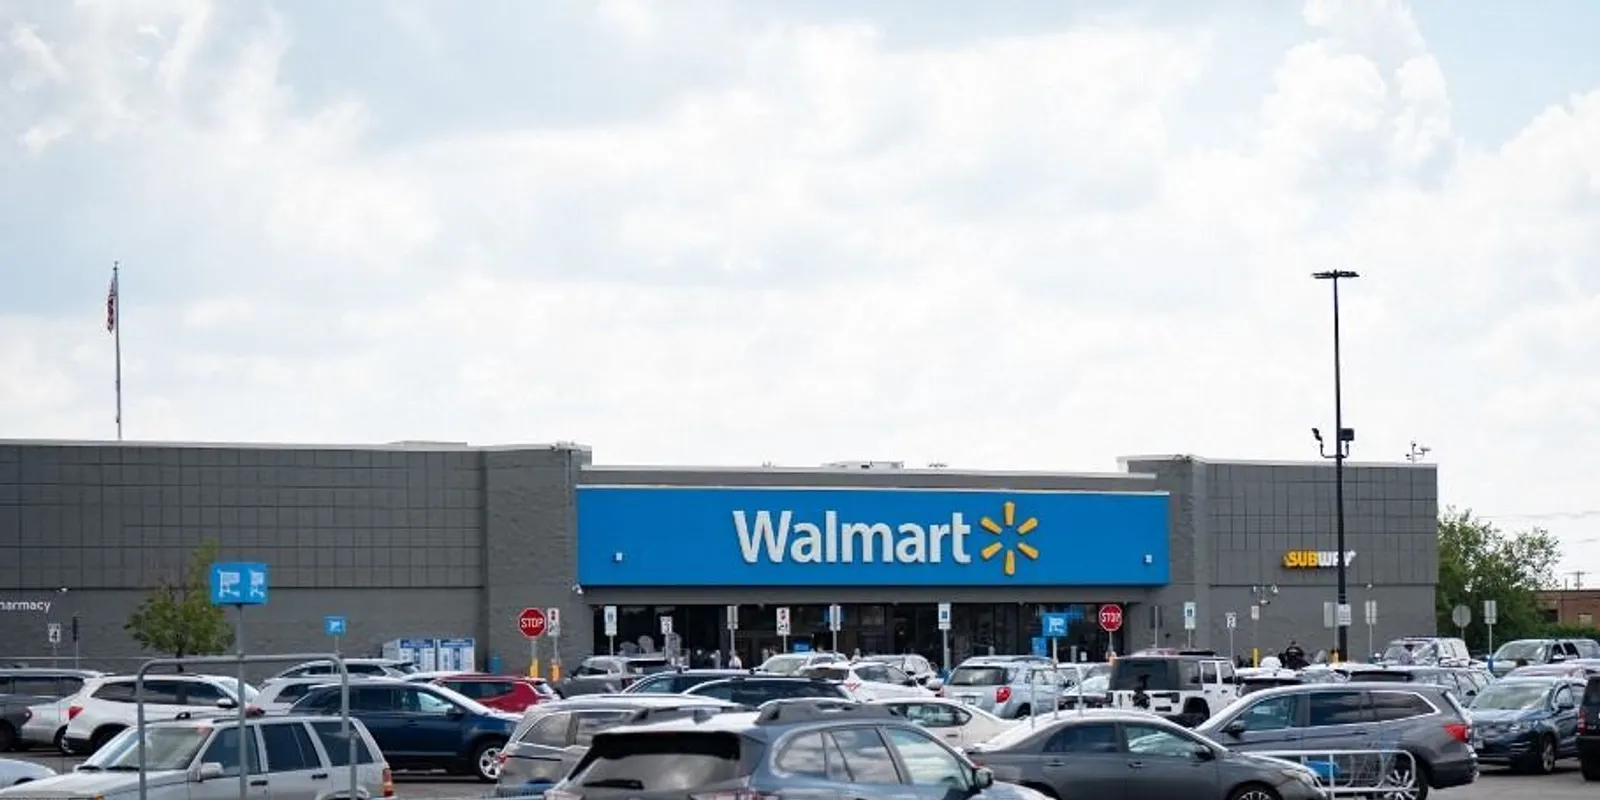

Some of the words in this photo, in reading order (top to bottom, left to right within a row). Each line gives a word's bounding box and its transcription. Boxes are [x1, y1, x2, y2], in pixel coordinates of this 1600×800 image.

[732, 510, 972, 563] Walmart
[1101, 612, 1121, 622] STOP
[521, 618, 543, 628] STOP
